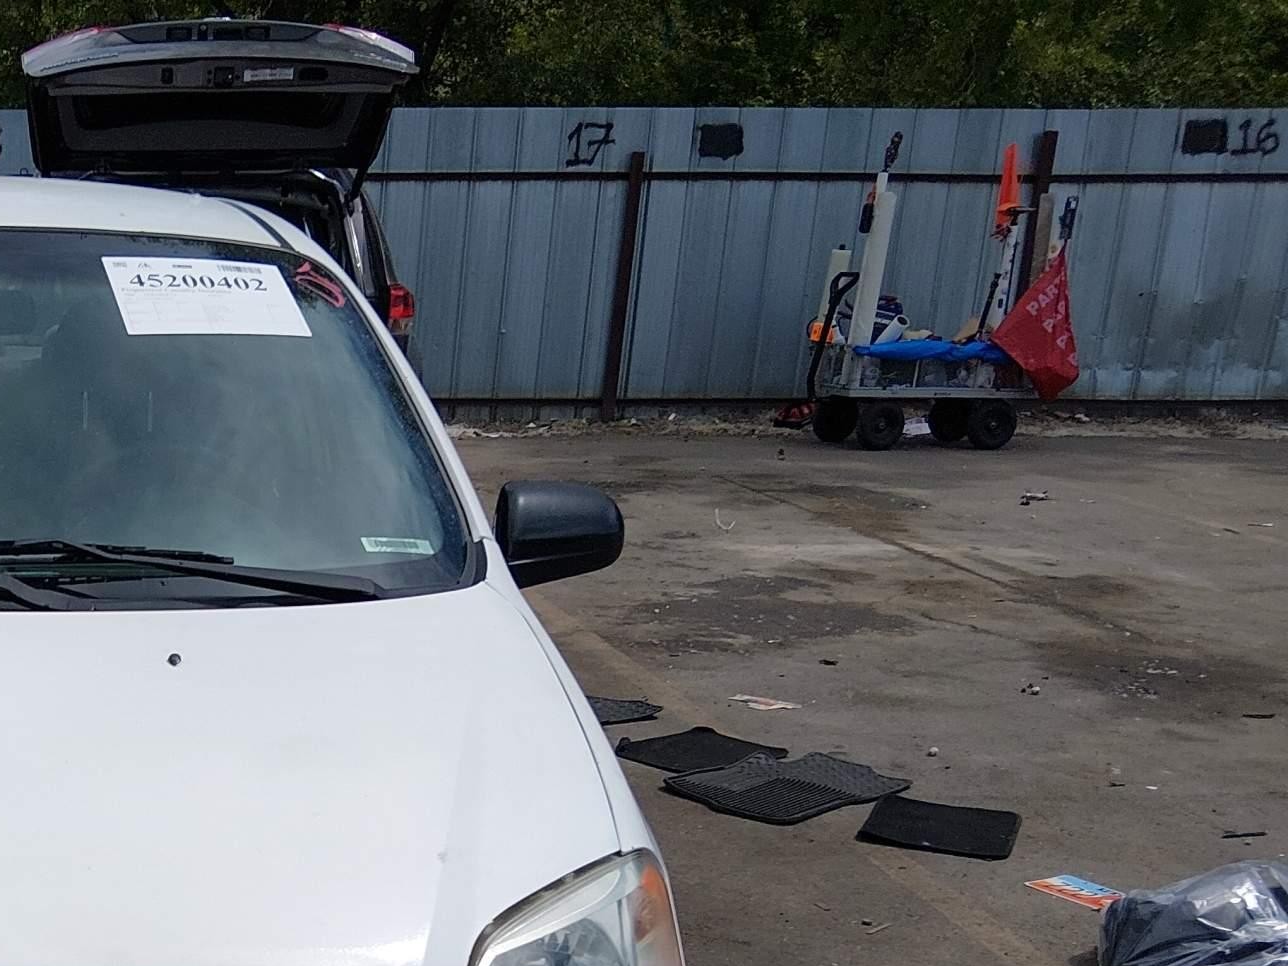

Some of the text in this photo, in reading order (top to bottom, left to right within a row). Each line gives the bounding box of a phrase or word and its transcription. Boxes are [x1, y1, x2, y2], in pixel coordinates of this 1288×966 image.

[565, 122, 615, 168] 17
[1231, 118, 1280, 158] 16
[129, 273, 267, 292] 45200402
